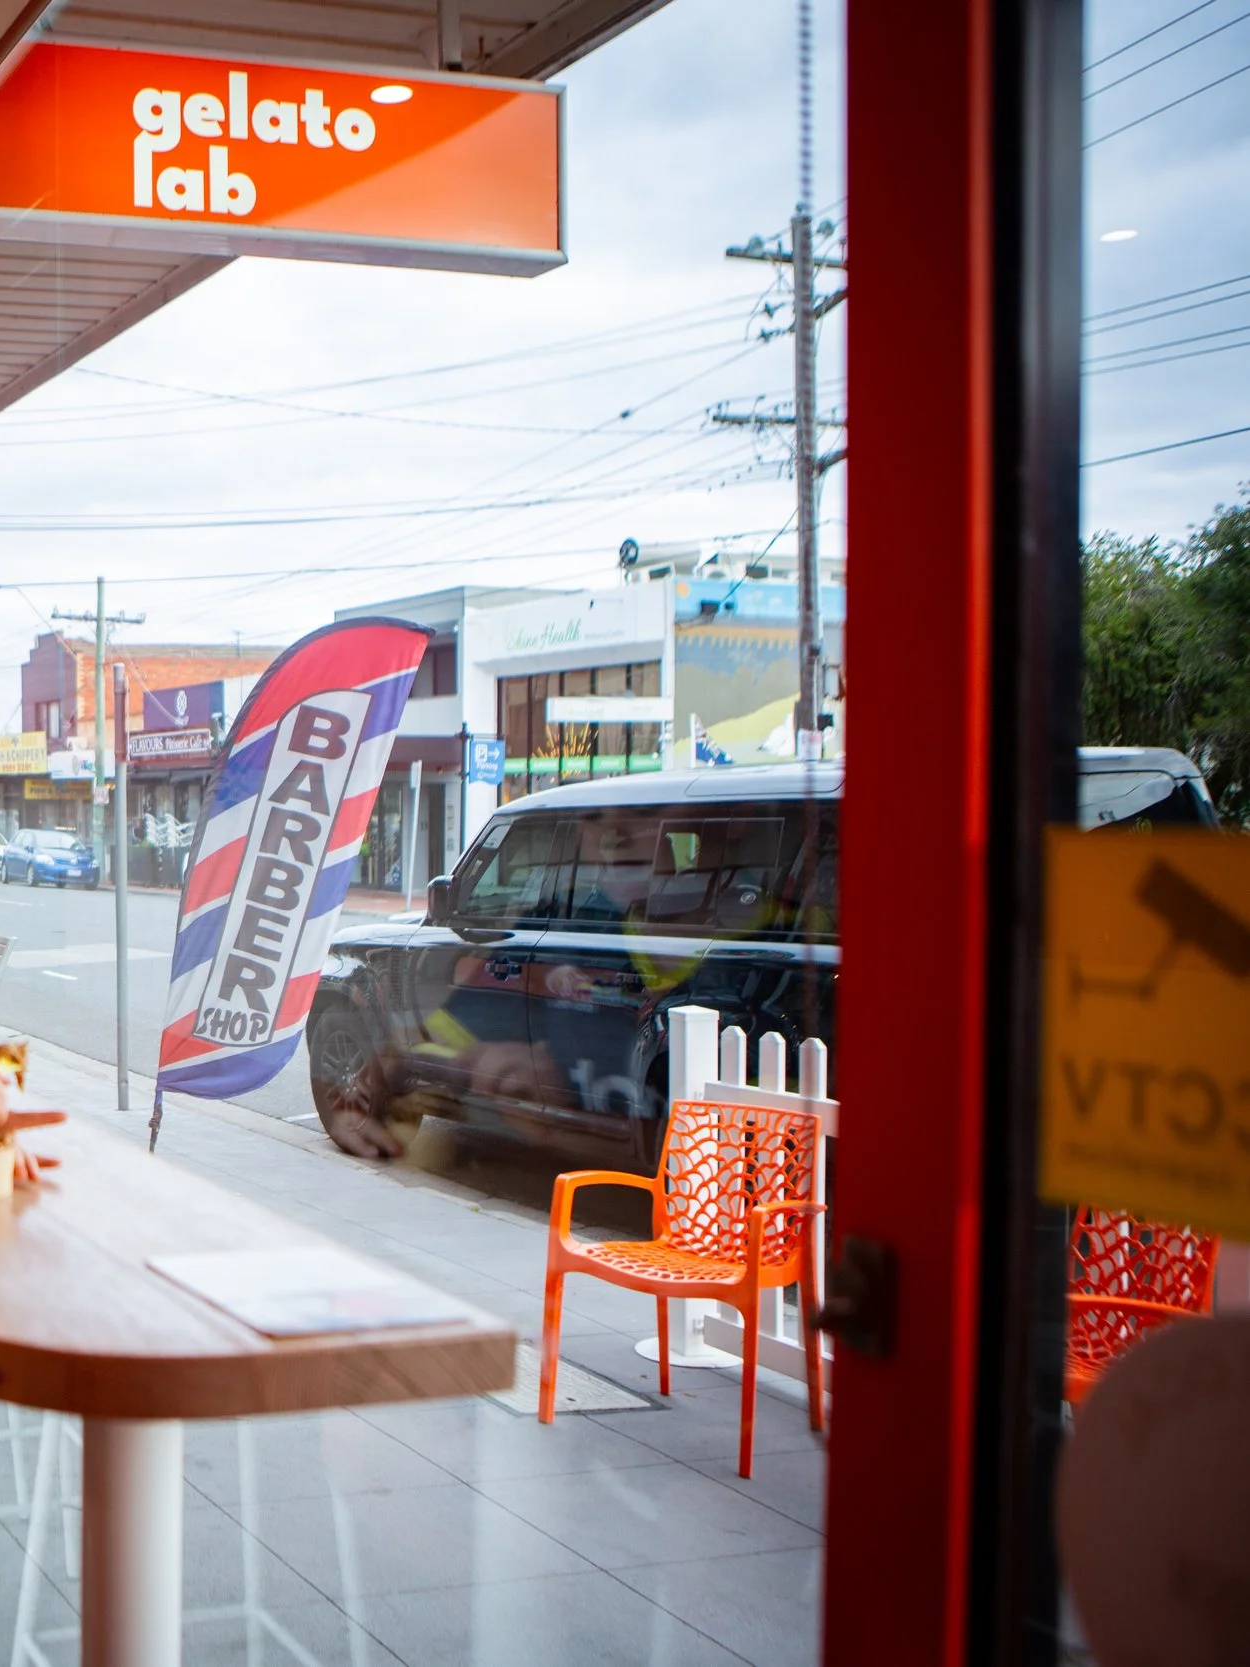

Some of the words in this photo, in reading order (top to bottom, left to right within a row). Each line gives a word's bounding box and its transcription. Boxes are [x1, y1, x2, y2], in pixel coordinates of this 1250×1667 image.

[133, 71, 376, 152] gelato
[134, 136, 257, 216] lab
[540, 618, 581, 650] Health
[132, 736, 163, 753] FLAVOURS
[218, 704, 351, 1014] BARBER
[195, 1007, 269, 1042] SHOP
